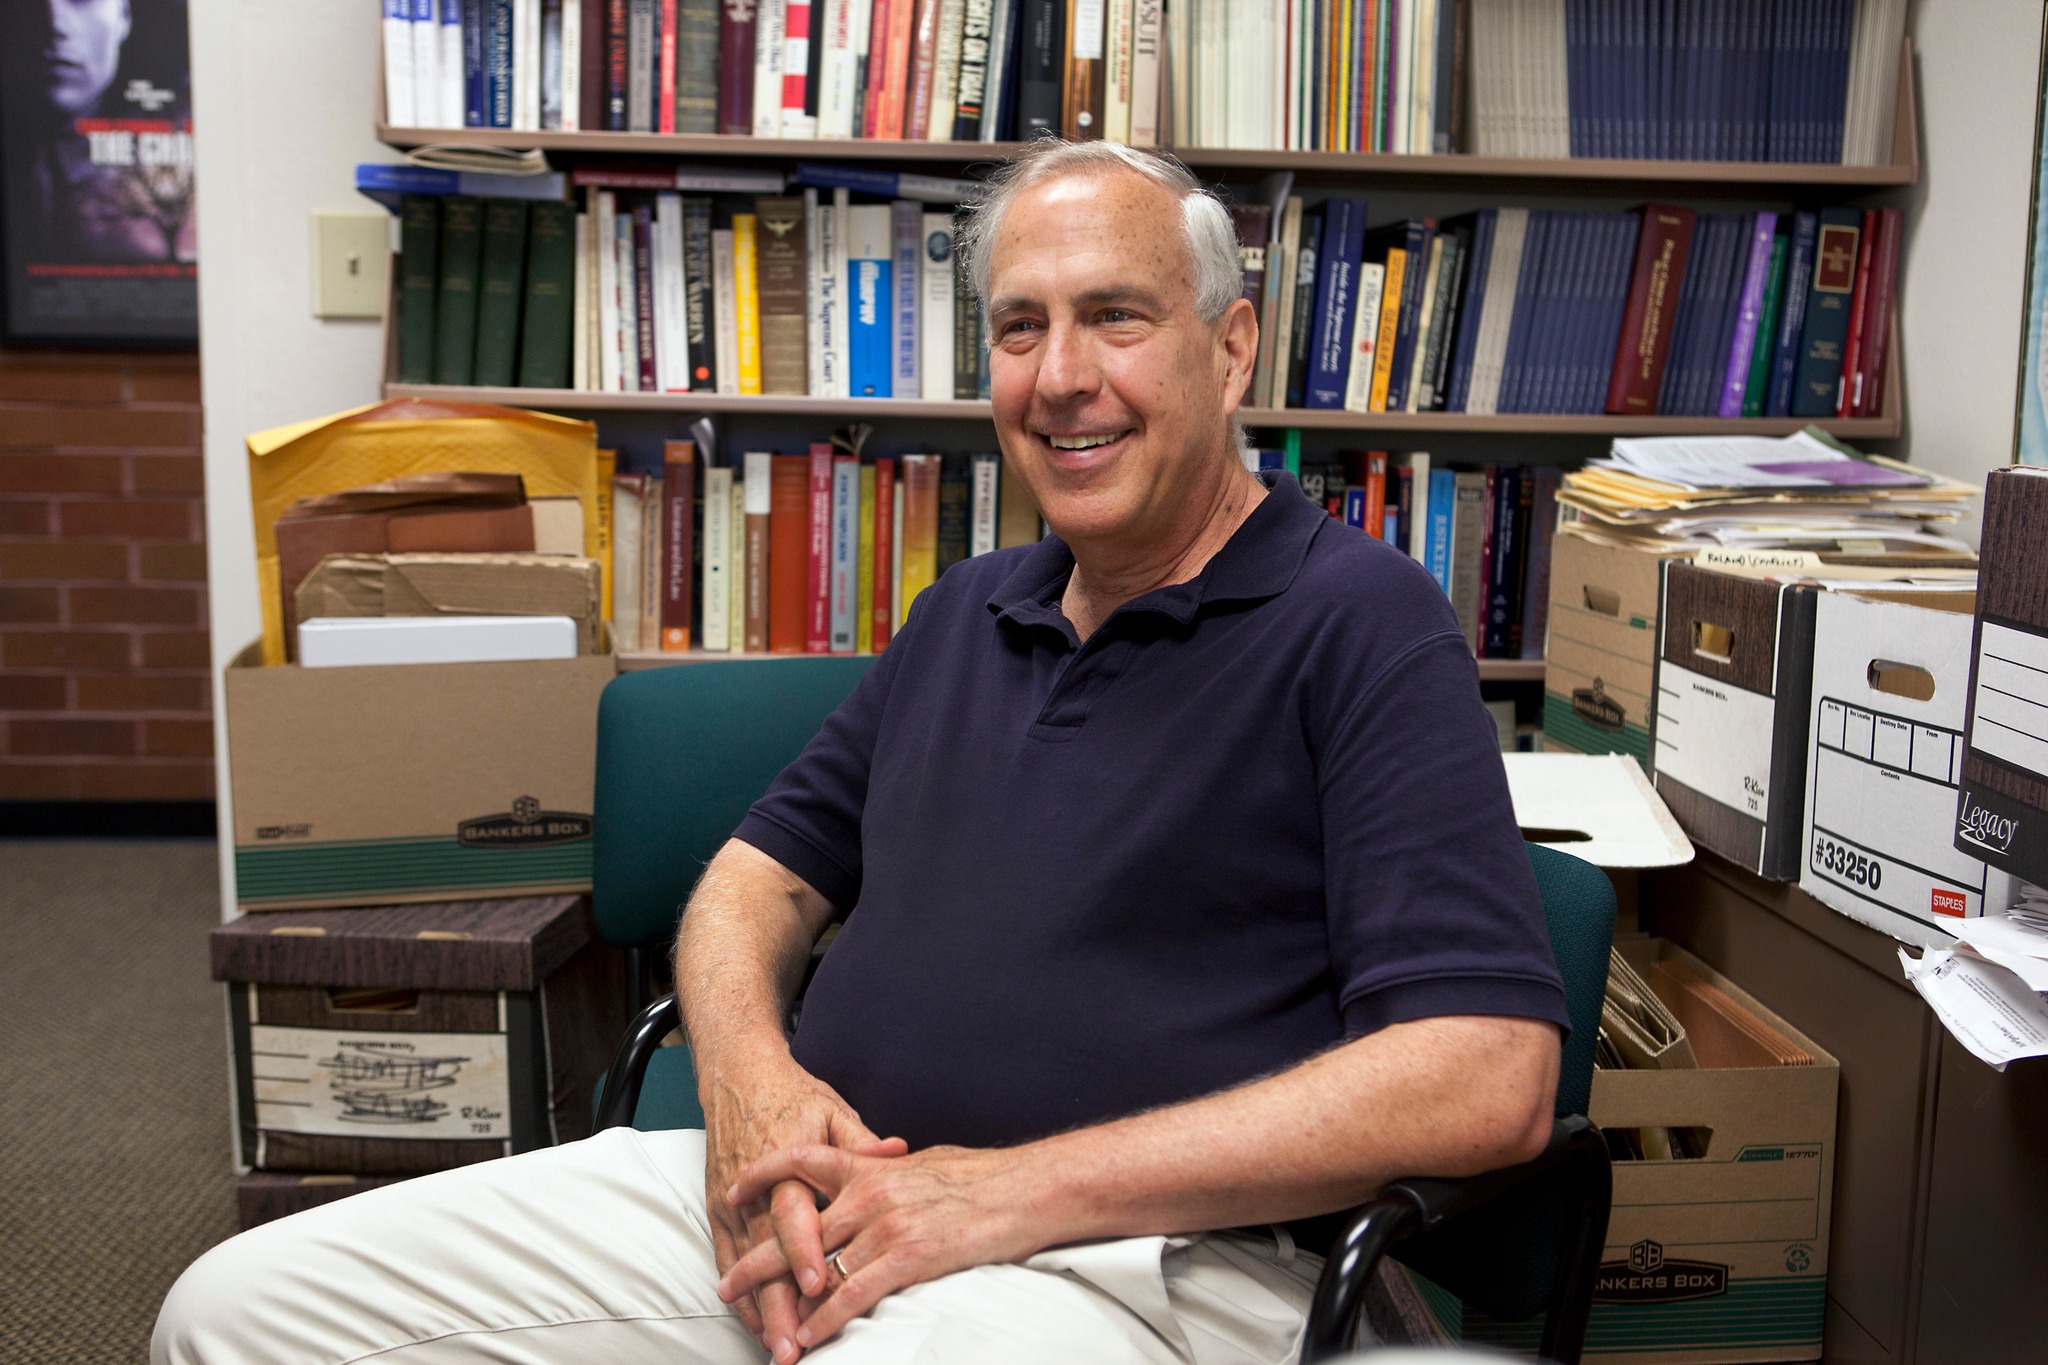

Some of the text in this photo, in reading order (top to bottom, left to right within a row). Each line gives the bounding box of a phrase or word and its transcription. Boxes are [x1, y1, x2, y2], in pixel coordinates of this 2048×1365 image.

[1338, 261, 1351, 290] Inside
[819, 276, 837, 383] The Supreme Court
[1332, 305, 1347, 343] Supreme
[1879, 718, 1908, 731] Destroy Date
[1925, 729, 1939, 739] From
[1880, 769, 1901, 781] Contents
[1747, 796, 1759, 811] 725
[1960, 790, 2017, 851] Legacy
[464, 821, 585, 841] BANKERS BOX
[1815, 838, 1883, 891] #33250
[1932, 894, 1965, 912] STAPLES
[1674, 1273, 1716, 1288] BOX
